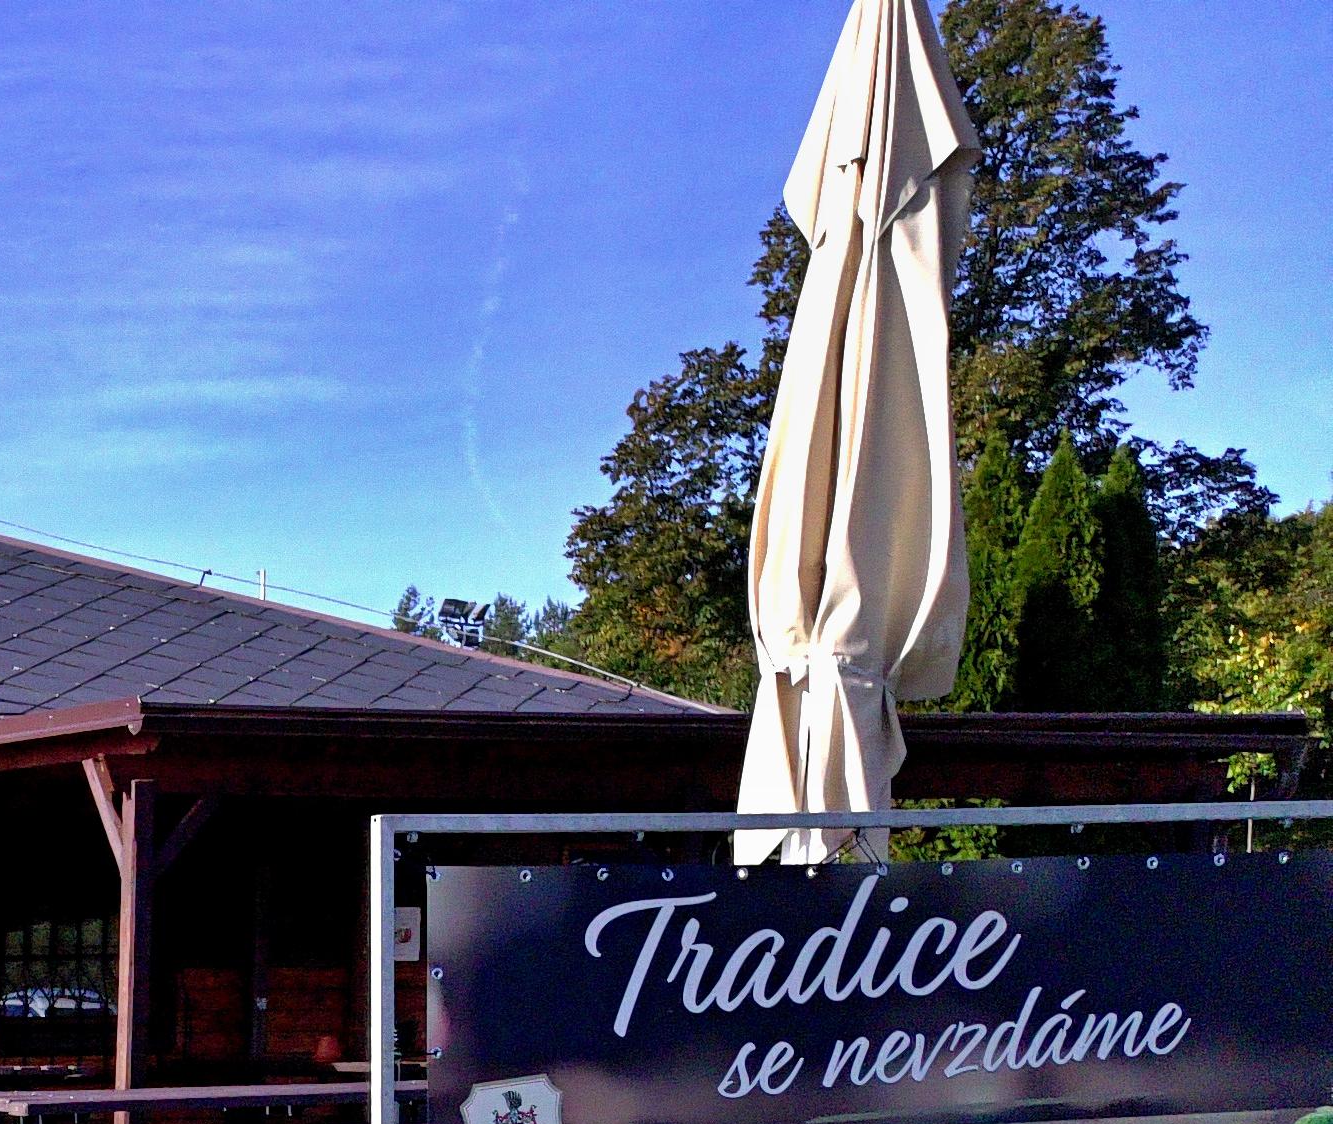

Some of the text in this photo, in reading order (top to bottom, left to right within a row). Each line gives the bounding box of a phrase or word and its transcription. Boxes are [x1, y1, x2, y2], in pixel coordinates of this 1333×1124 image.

[584, 874, 1022, 1037] Tradice
[717, 986, 1192, 1098] se nevzdáme
